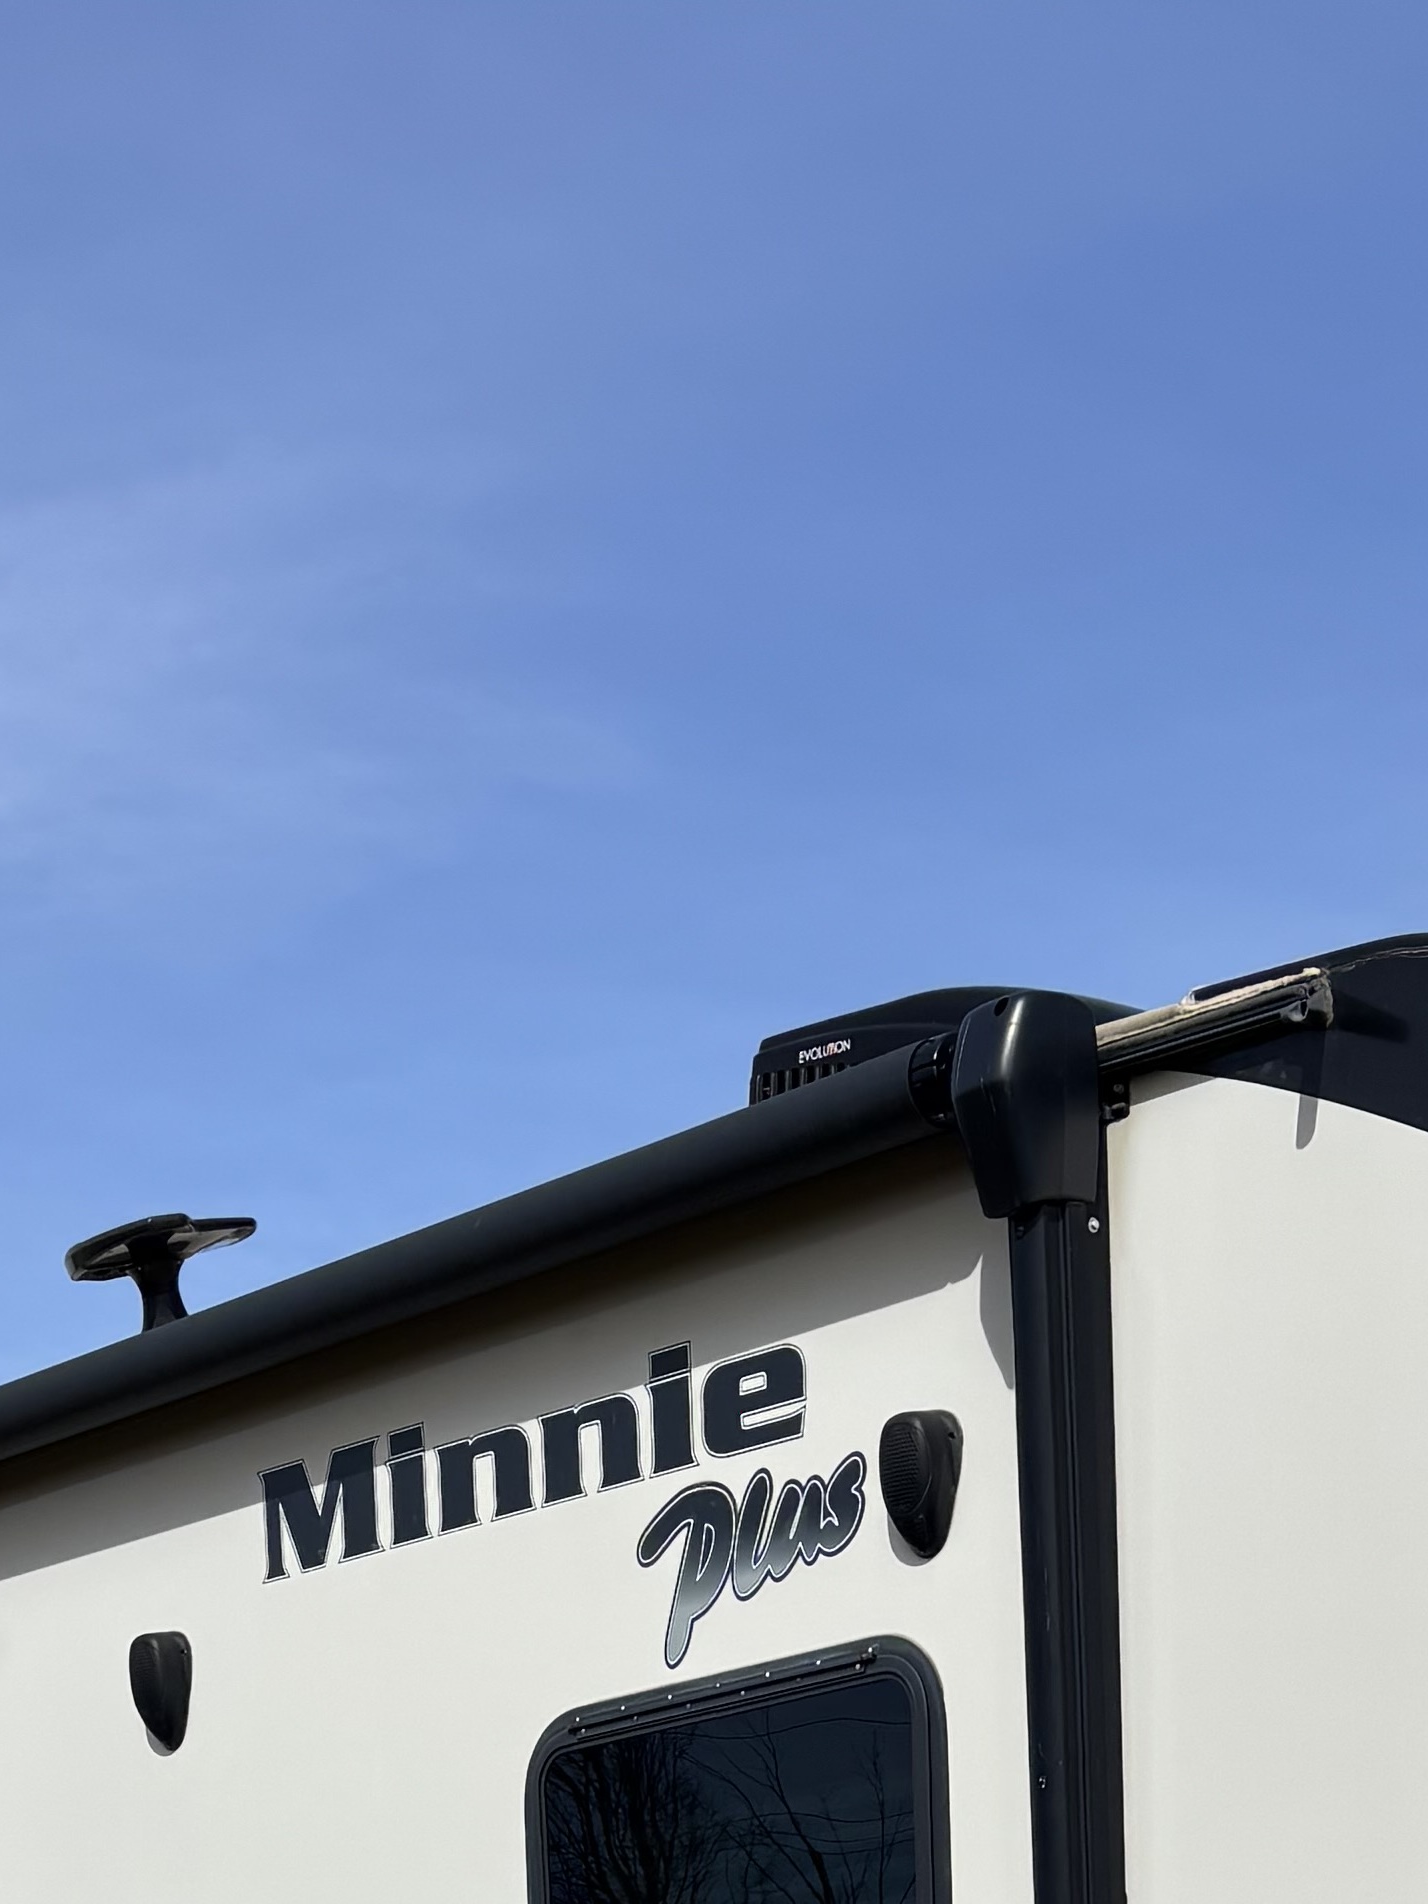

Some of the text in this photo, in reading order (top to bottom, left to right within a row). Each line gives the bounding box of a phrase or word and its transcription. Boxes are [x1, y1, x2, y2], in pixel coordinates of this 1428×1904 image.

[798, 1038, 851, 1064] EVOLUTION
[258, 1341, 807, 1584] Minnie
[637, 1451, 868, 1668] Plus
